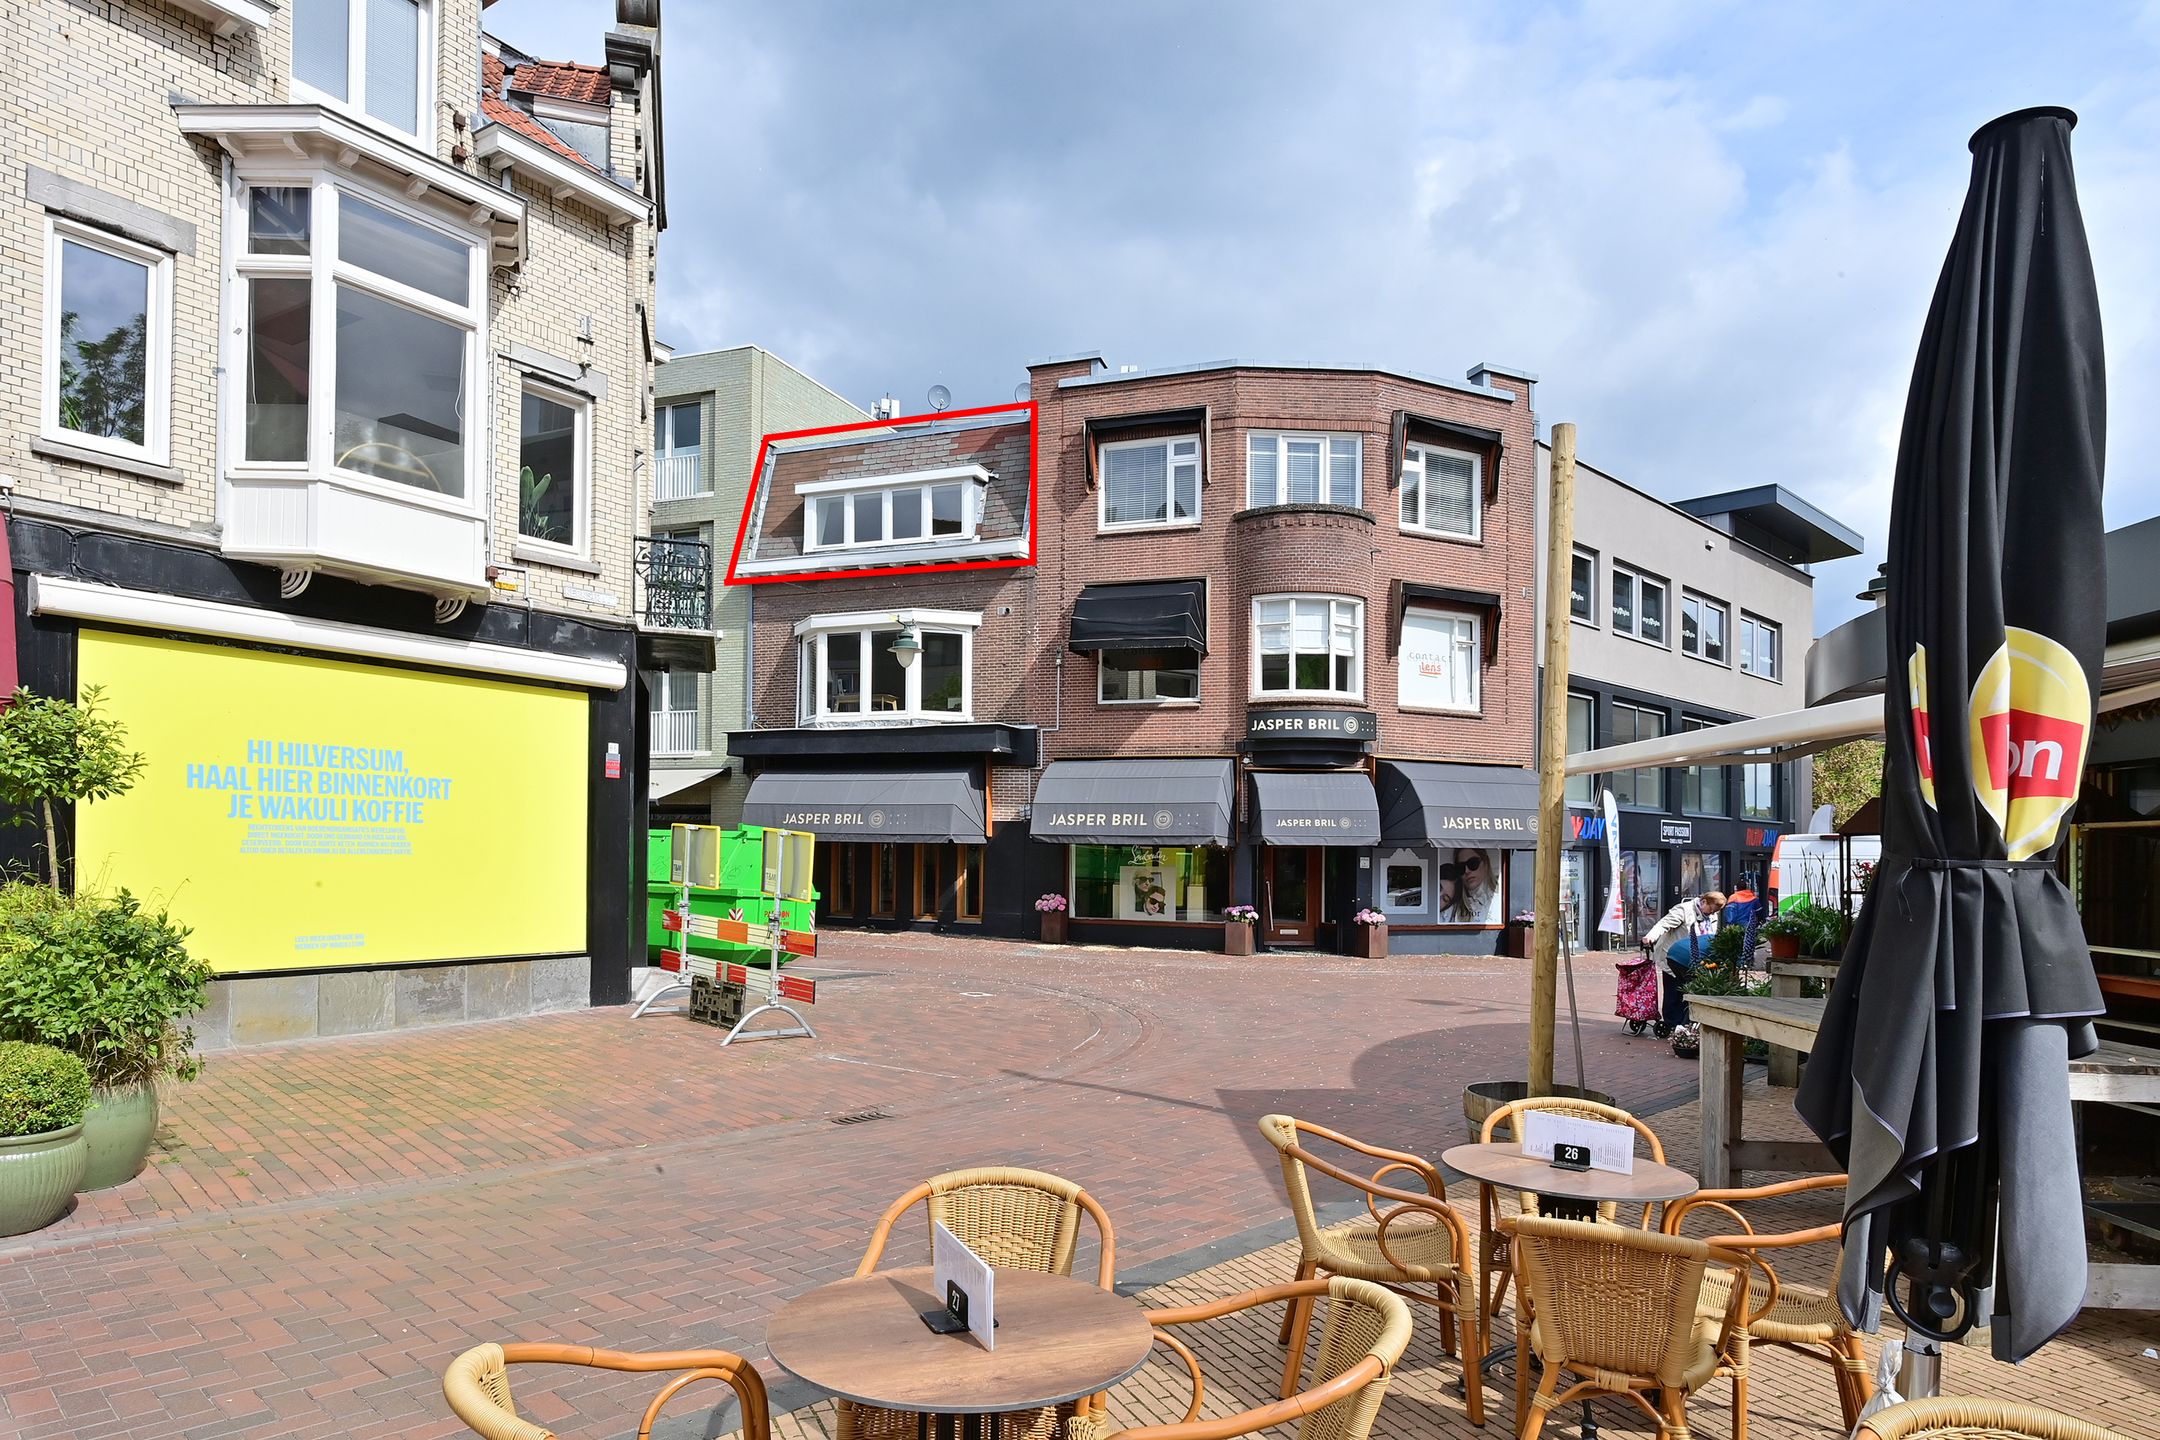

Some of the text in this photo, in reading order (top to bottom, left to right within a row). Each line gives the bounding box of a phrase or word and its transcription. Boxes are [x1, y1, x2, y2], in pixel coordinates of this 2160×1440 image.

[1251, 718, 1340, 731] JASPER BRIL
[247, 739, 410, 775] HI HILVERSUM,
[187, 764, 452, 800] HAAL HIER BINNENKORT
[227, 794, 424, 824] JE WAKULI KOFFIE
[782, 813, 864, 825] JASPER BRIL
[1049, 813, 1148, 826] JASPER BRIL
[1276, 819, 1337, 827] JASPER BRIL
[1442, 816, 1524, 830] JASPER BRIL
[1564, 1146, 1579, 1160] 26
[951, 1289, 960, 1312] 27
